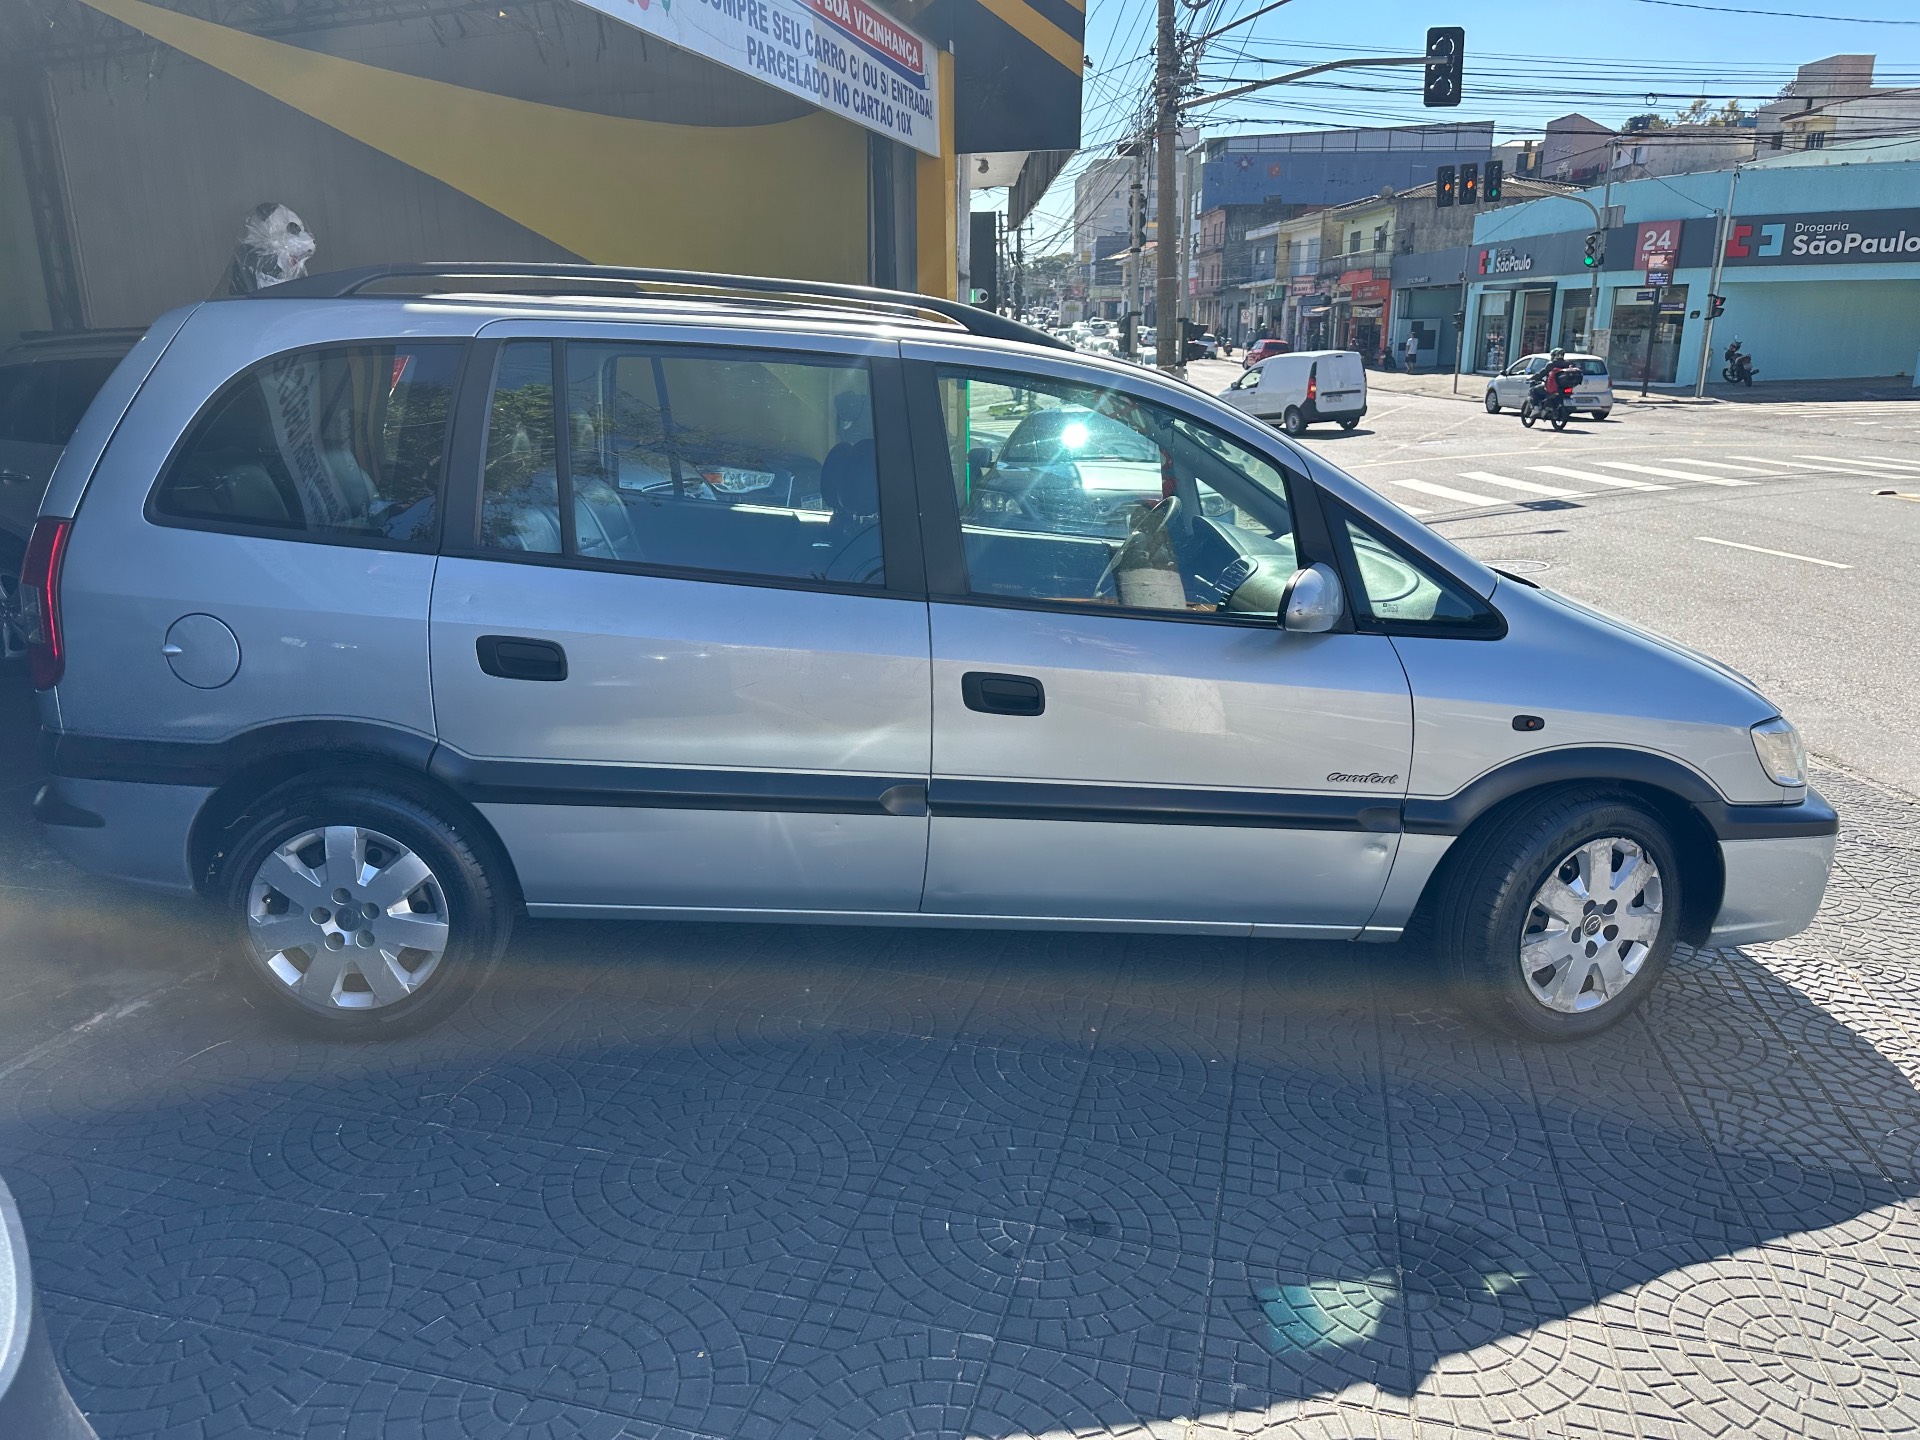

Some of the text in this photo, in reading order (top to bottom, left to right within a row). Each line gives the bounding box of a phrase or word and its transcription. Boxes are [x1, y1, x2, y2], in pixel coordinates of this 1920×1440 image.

[853, 6, 919, 67] VIZINHANÇA
[700, 0, 769, 35] MPRE
[772, 10, 801, 50] SEU
[804, 28, 847, 75] CARRO
[862, 61, 878, 91] OU
[891, 77, 933, 121] ENTRADA!
[746, 34, 830, 99] PARCELADO
[832, 76, 849, 108] NO
[895, 108, 913, 136] 10X
[1642, 230, 1671, 251] 24
[1795, 222, 1850, 234] Drogaria
[1791, 230, 1920, 256] SãoPaulo
[1326, 771, 1399, 785] Comfort
